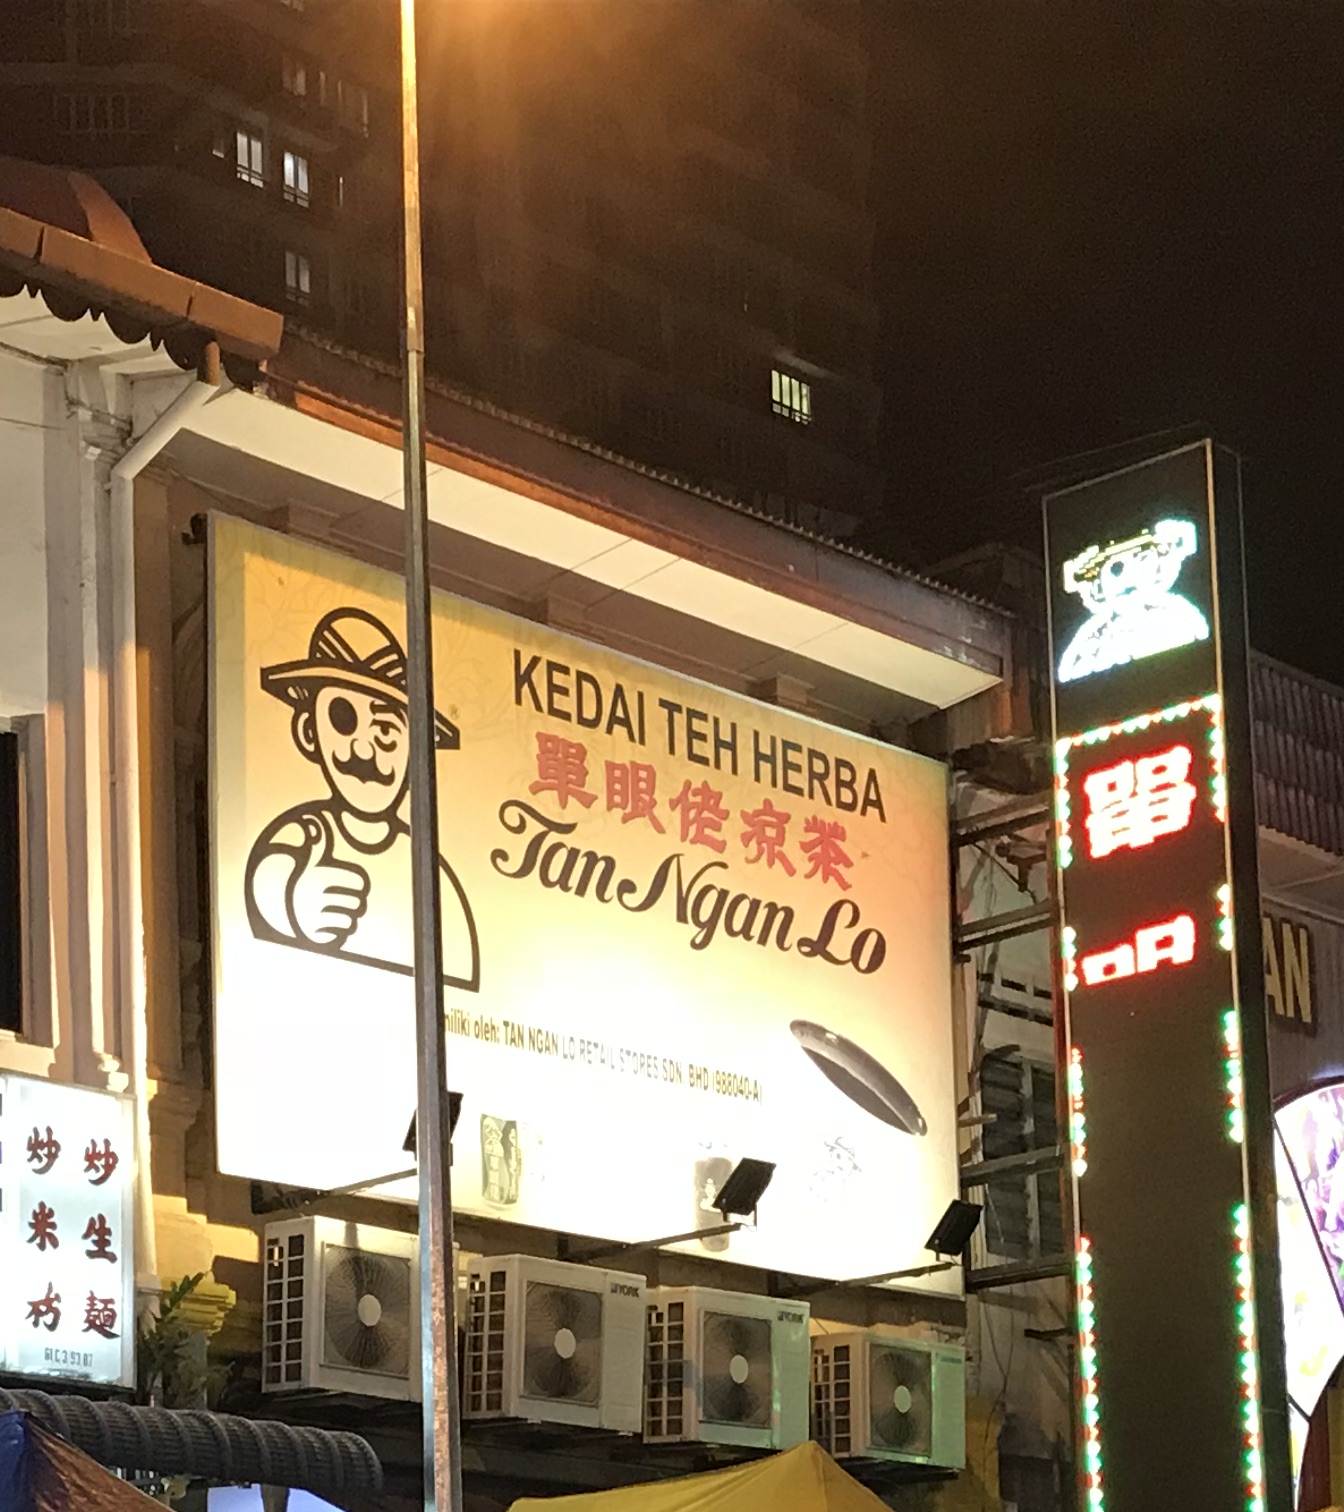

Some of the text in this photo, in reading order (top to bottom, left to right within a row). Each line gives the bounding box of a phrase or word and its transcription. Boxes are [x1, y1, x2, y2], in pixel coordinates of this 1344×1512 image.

[513, 647, 888, 824] KEDAI TEH HERBA
[490, 800, 888, 976] Tan Ngan Lo
[474, 1016, 500, 1044] oleh:
[503, 1020, 525, 1051] TAN
[528, 1026, 559, 1056] NGAN
[688, 1064, 709, 1092] BHD
